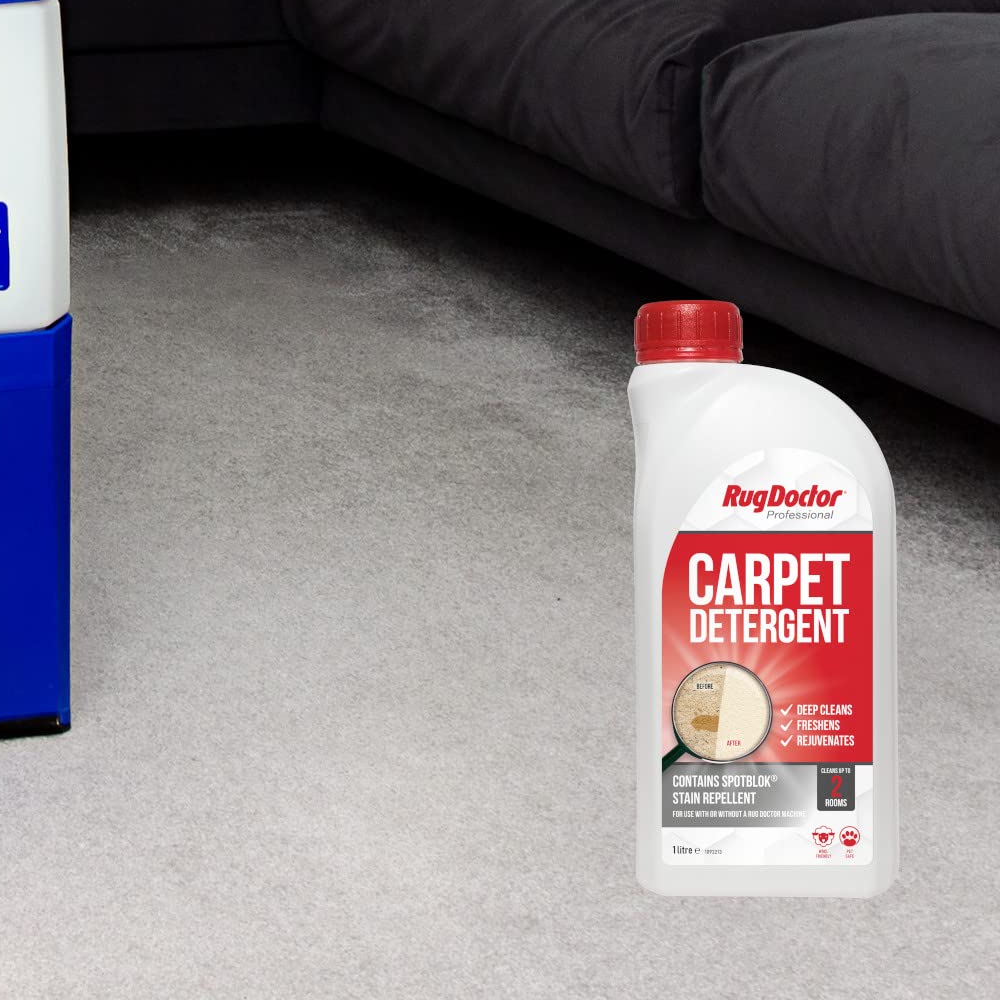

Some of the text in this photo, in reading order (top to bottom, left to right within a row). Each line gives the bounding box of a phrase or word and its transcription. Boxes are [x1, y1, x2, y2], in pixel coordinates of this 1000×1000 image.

[766, 510, 834, 520] Professional
[688, 552, 850, 606] CARPET
[690, 608, 849, 643] DETERGENT
[797, 704, 853, 716] DEEP CLEANS
[797, 719, 840, 731] FRESHENS
[797, 735, 855, 747] REJUVENATES
[672, 775, 720, 788] CONTAINS
[831, 775, 843, 798] 2
[672, 791, 756, 804] STAIN REPELLENT
[825, 798, 847, 807] ROOMS
[672, 810, 683, 818] FOR
[684, 810, 694, 818] USE
[695, 810, 709, 818] WITH
[710, 810, 717, 818] OR
[718, 810, 742, 818] WITHOUT
[760, 810, 781, 818] DOCTOR
[677, 845, 693, 855] litre
